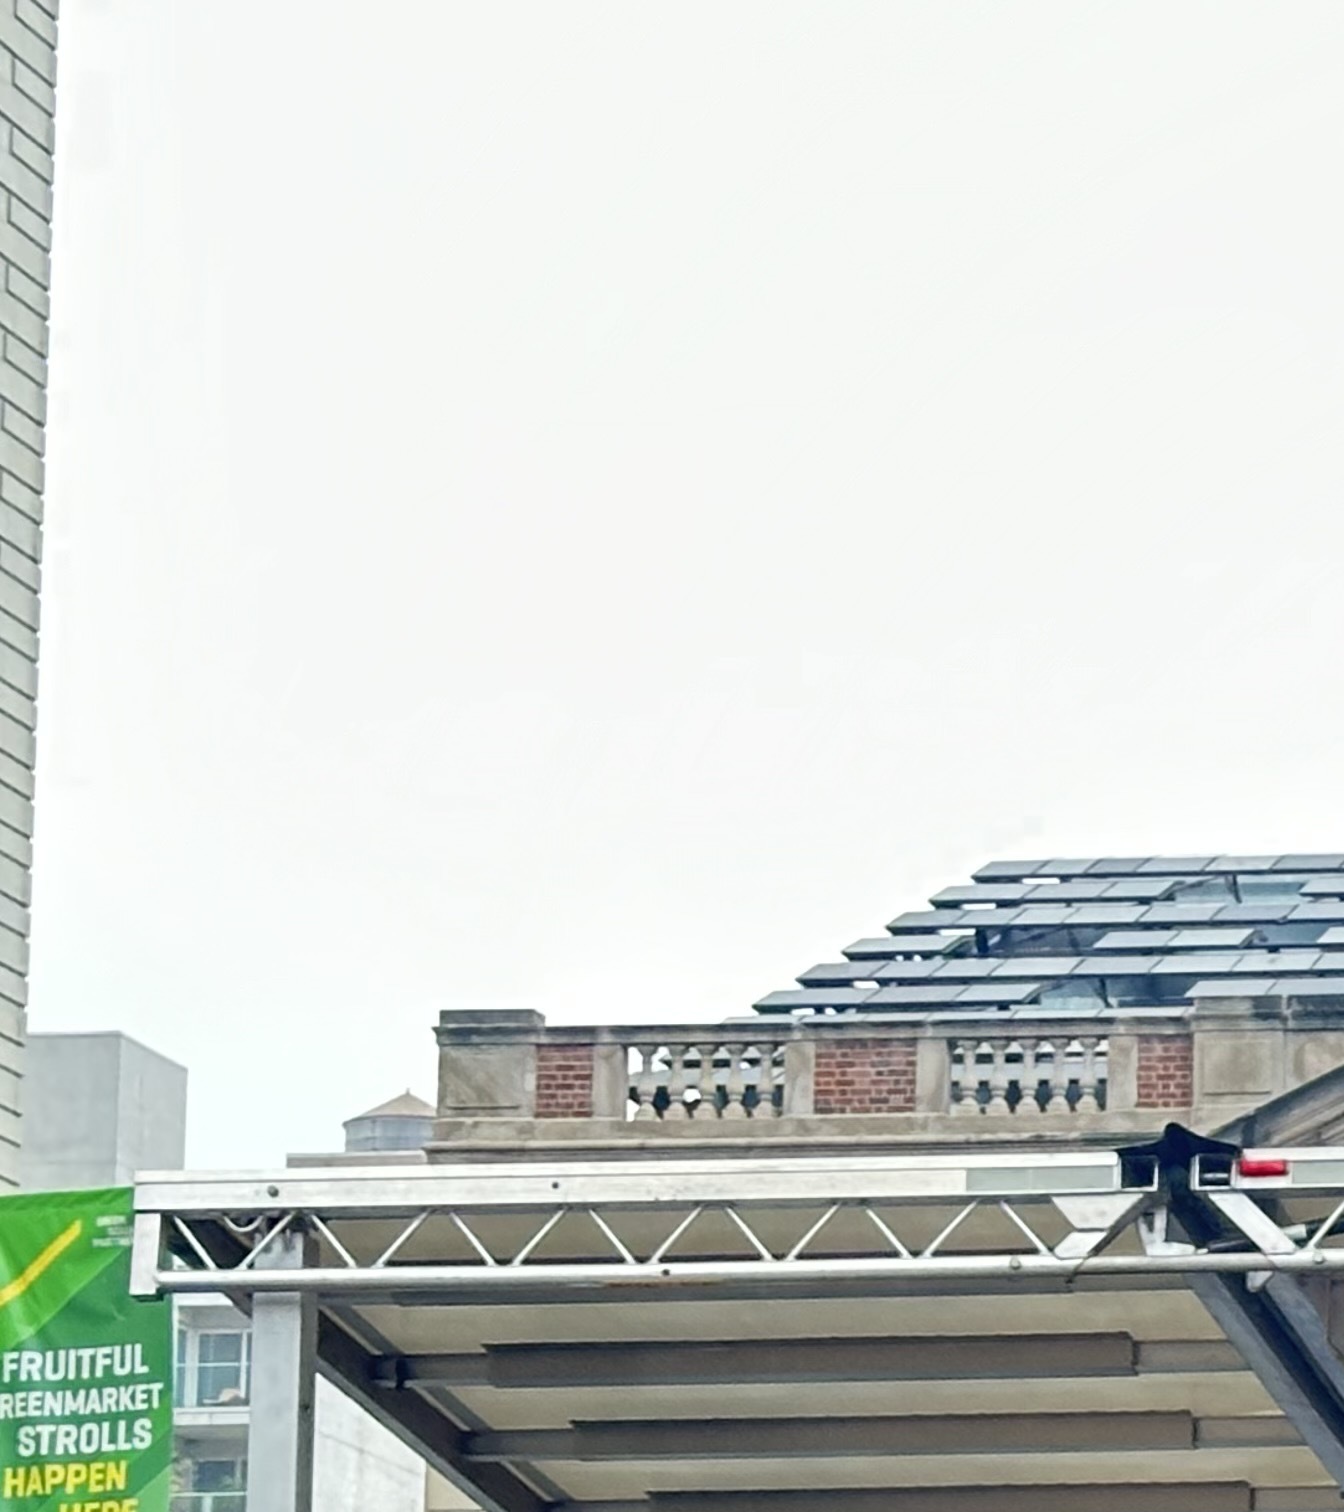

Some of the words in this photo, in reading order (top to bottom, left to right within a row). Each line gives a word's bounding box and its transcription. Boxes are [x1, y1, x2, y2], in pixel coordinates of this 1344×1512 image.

[3, 1343, 149, 1383] FRUITFUL
[17, 1418, 152, 1457] STROLLS
[3, 1460, 127, 1499] HAPPEN
